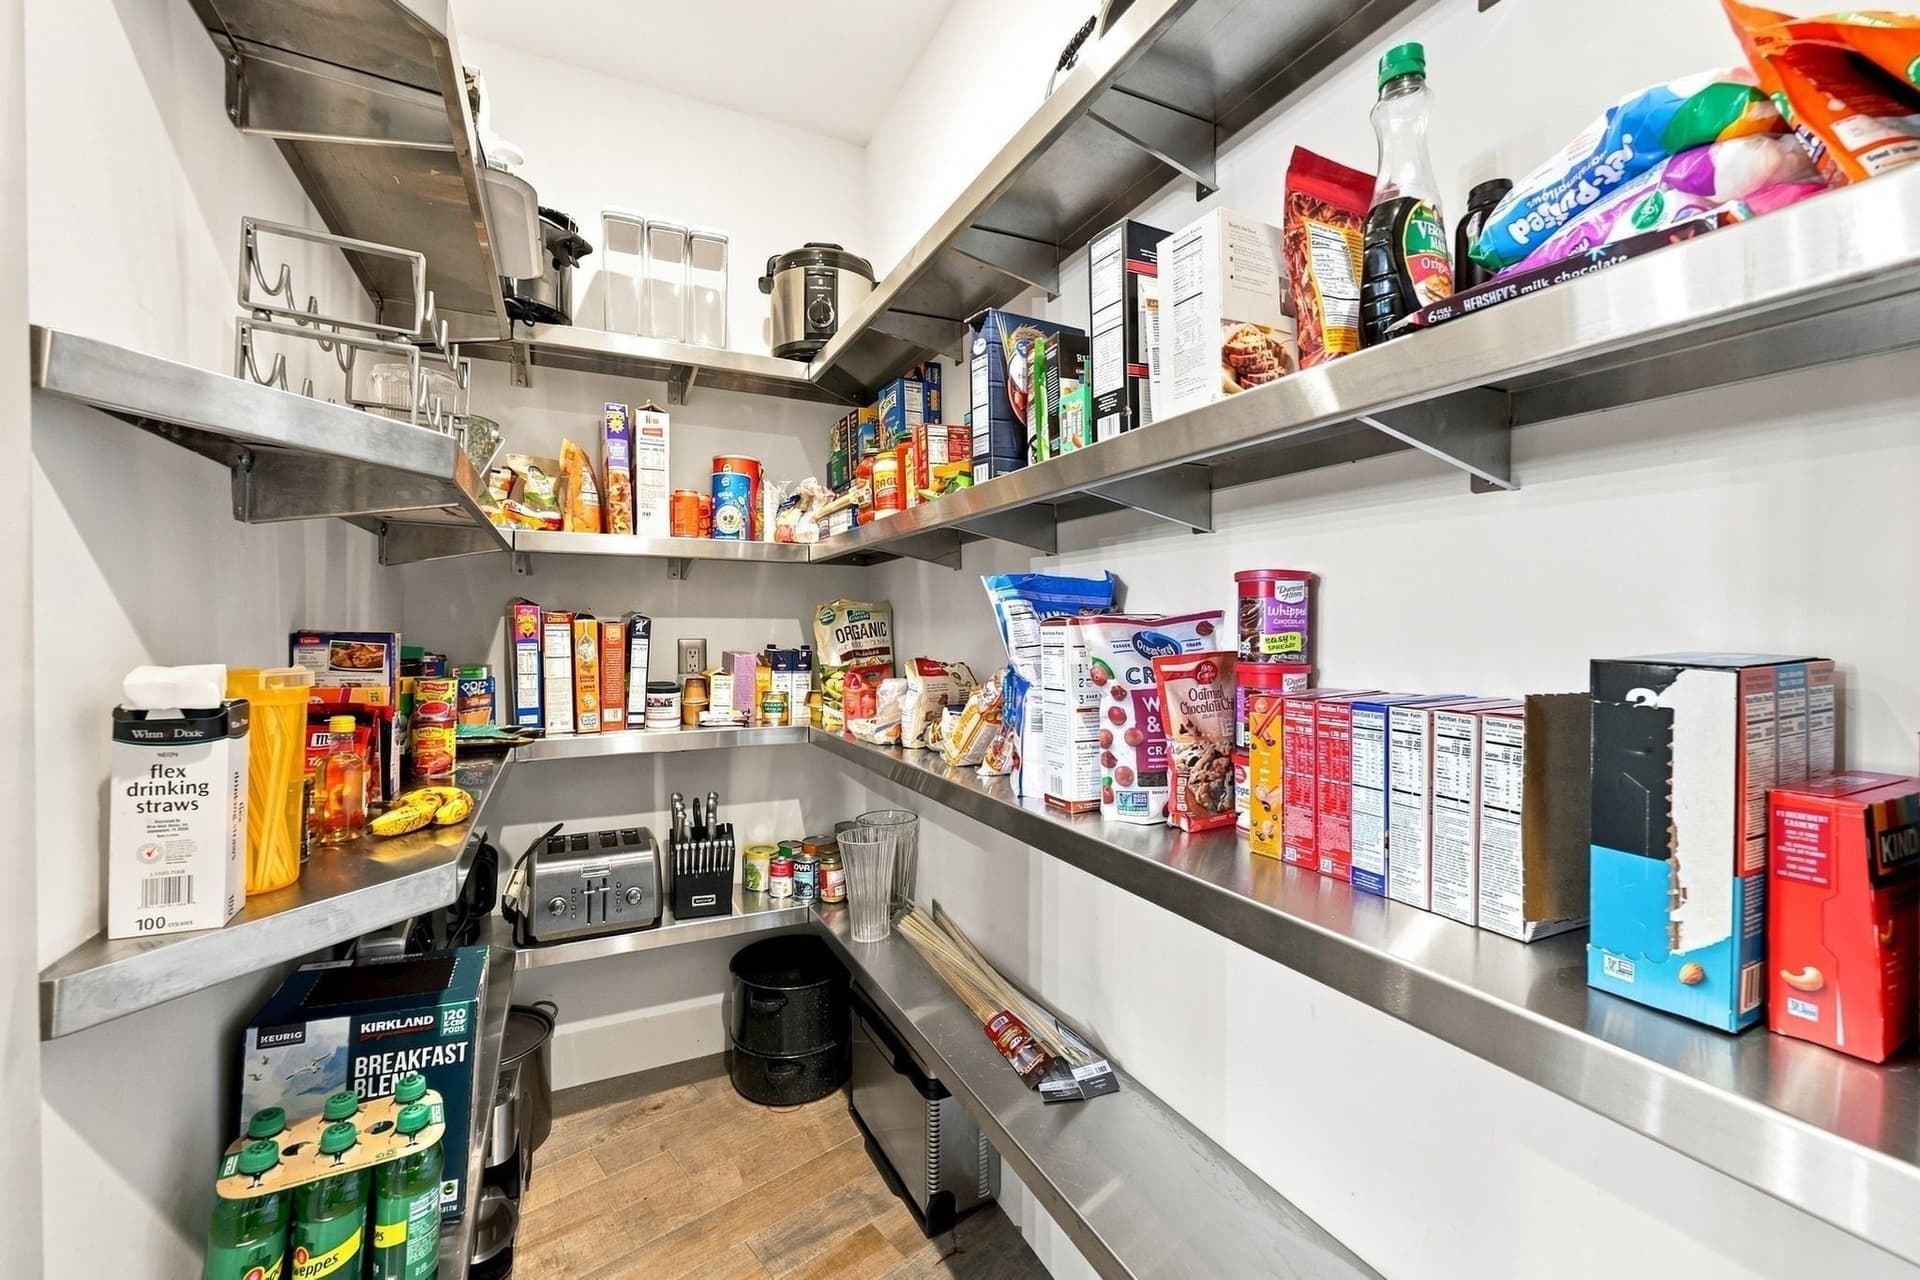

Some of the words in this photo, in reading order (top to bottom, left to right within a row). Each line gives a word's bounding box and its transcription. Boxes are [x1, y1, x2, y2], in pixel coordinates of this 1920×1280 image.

[1464, 284, 1518, 312] HERSHEY'S
[1521, 279, 1550, 294] milk
[1428, 310, 1437, 323] 6
[835, 621, 887, 644] ORGANIC
[1264, 634, 1289, 644] easy
[1078, 678, 1085, 687] 2
[1079, 694, 1085, 704] 3
[131, 729, 164, 739] Winn
[173, 728, 205, 738] Dixie
[150, 763, 187, 779] flex
[127, 780, 210, 797] drinking
[136, 799, 199, 814] straws
[1881, 827, 1918, 864] KIND
[793, 863, 810, 872] OYA
[135, 916, 166, 931] 100
[443, 1008, 466, 1020] 120
[360, 1015, 434, 1034] KIRKLAND
[260, 1031, 303, 1044] KEURIG
[354, 1041, 469, 1078] BREAKFAST
[353, 1070, 419, 1099] BLEN
